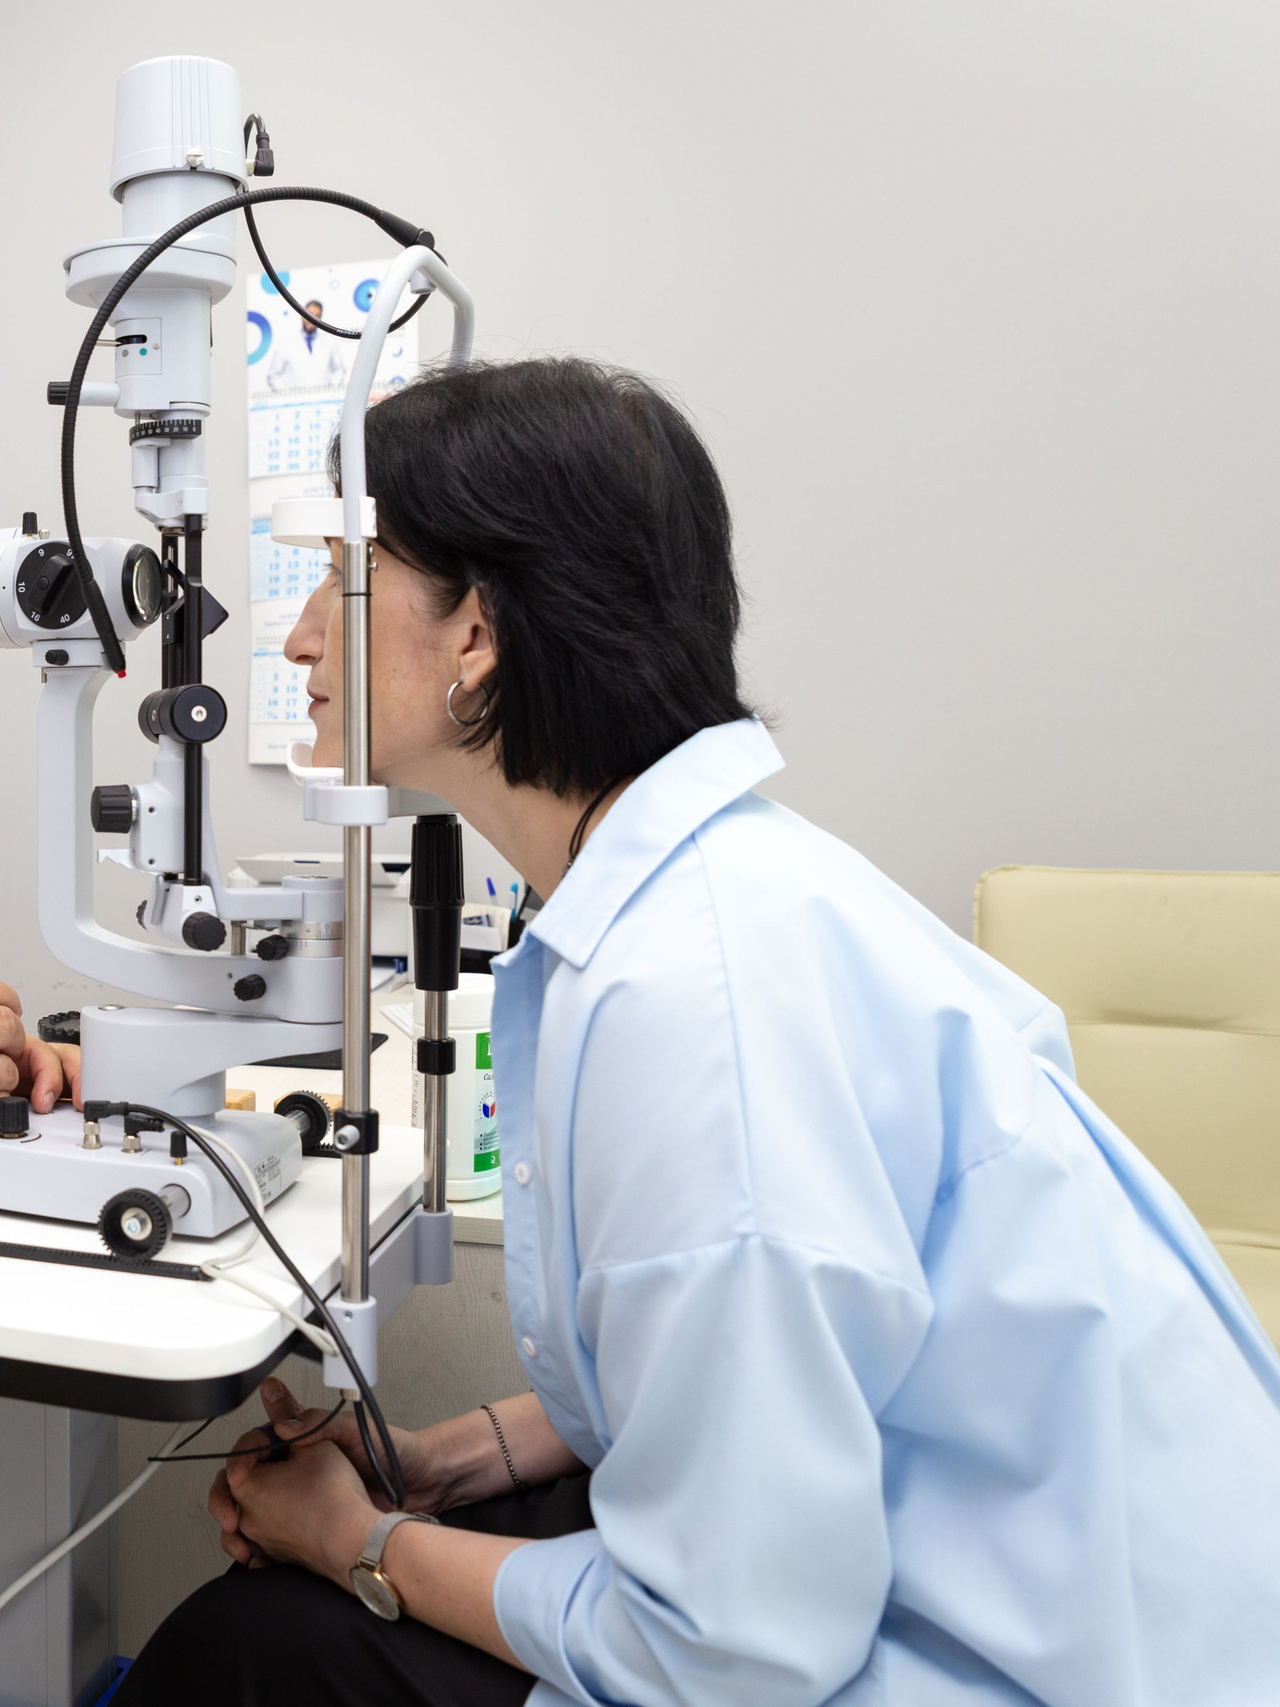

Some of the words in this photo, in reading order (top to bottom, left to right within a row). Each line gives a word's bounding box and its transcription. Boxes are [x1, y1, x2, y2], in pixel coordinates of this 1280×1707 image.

[18, 581, 26, 593] 10
[30, 611, 41, 622] 16
[60, 613, 70, 624] 40
[273, 672, 279, 681] 2
[286, 685, 298, 693] 10
[268, 698, 279, 707] 16
[286, 698, 298, 707] 17
[285, 711, 297, 720] 24
